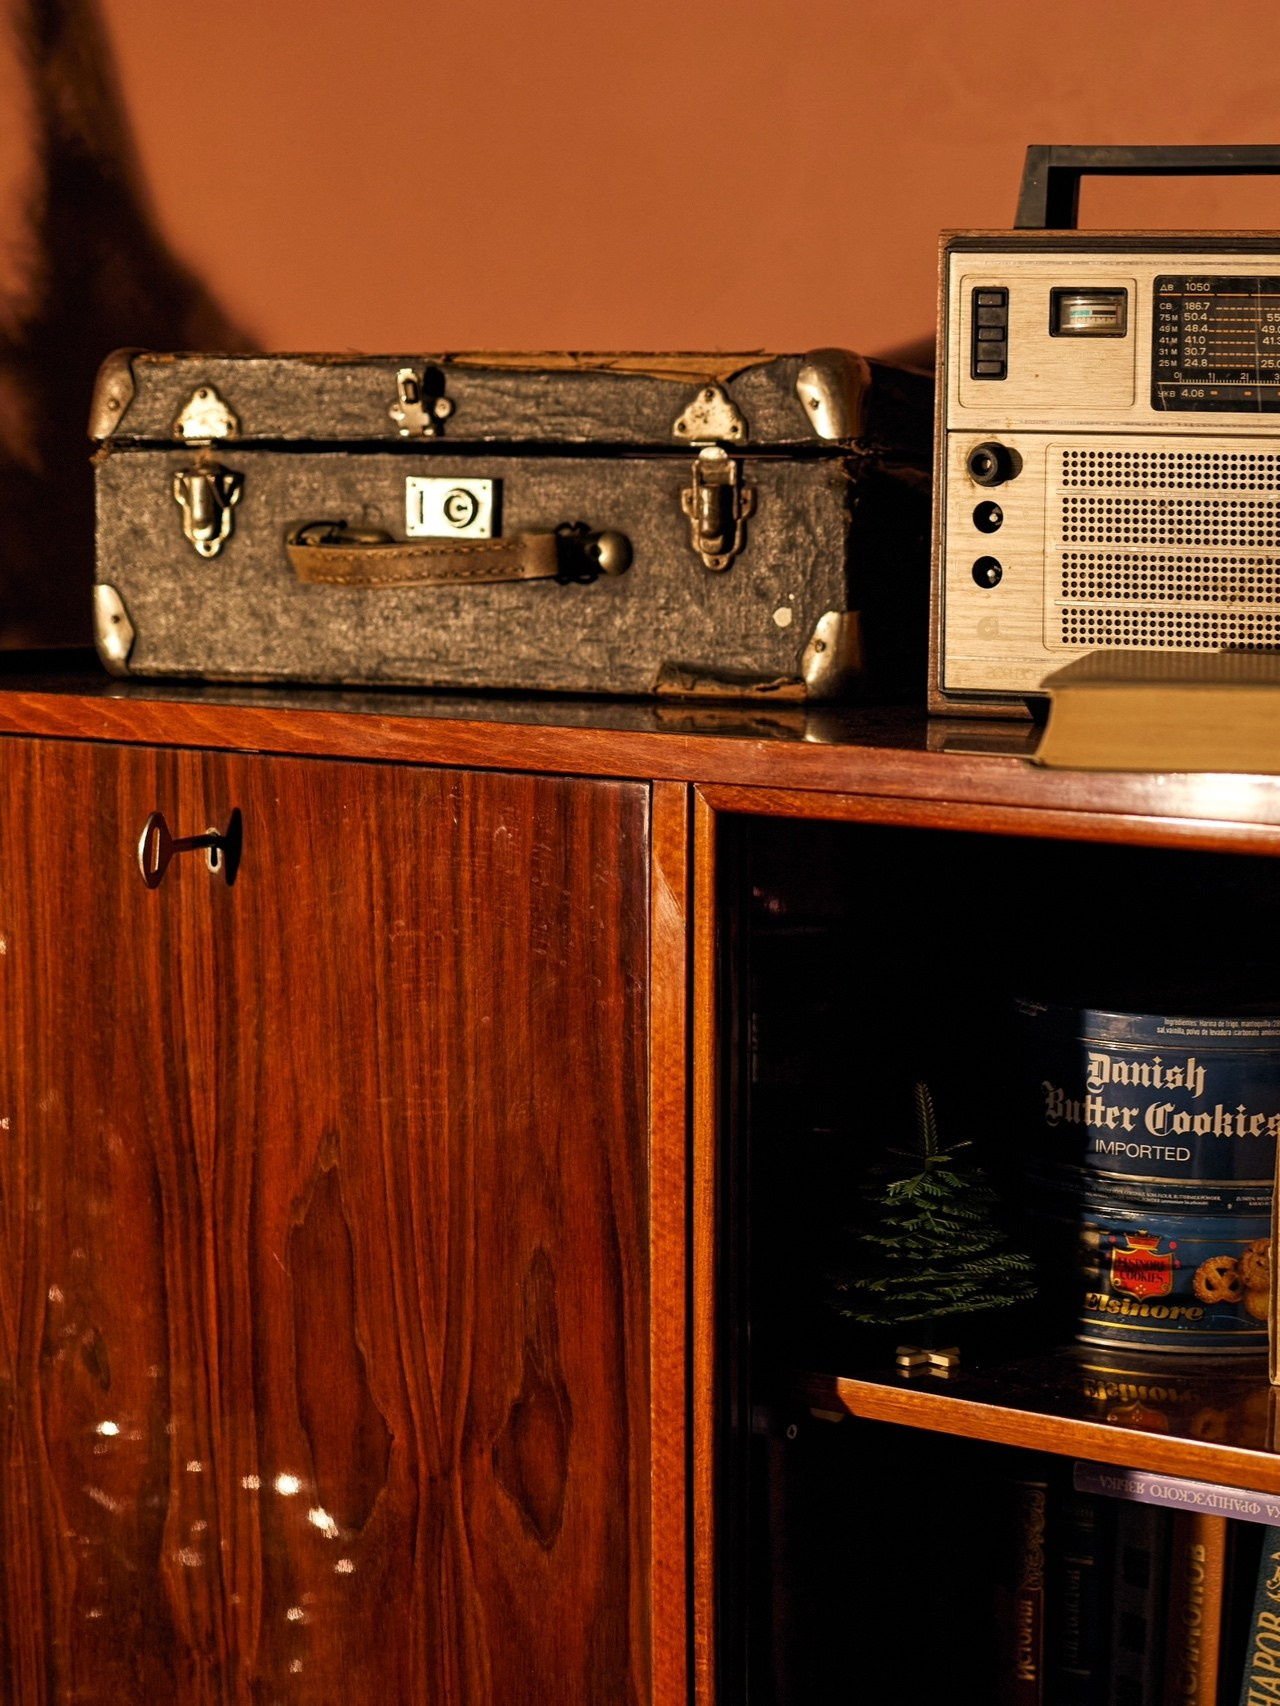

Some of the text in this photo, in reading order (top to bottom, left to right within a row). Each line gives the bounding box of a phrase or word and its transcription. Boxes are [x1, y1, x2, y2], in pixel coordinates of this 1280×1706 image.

[1185, 283, 1210, 291] 1050
[1185, 302, 1210, 310] 186.7
[1184, 313, 1207, 321] 50.4
[1266, 314, 1280, 322] 55
[1184, 324, 1208, 333] 48.4
[1184, 336, 1206, 344] 41.0
[1184, 348, 1206, 356] 30.7
[1184, 359, 1208, 368] 24.8
[1158, 390, 1176, 398] УКВ
[1181, 389, 1205, 398] 4.06
[1086, 1051, 1207, 1099] Danish
[1041, 1080, 1140, 1132] Butter
[1094, 1139, 1191, 1162] IMPORTED
[1117, 1257, 1166, 1271] ELSINORE
[1120, 1271, 1164, 1283] COOKIES
[1082, 1292, 1205, 1321] Elsinore
[1099, 1474, 1145, 1495] ЯЗЫКА
[1150, 1484, 1261, 1515] ФРАНЦУЗСКОГО
